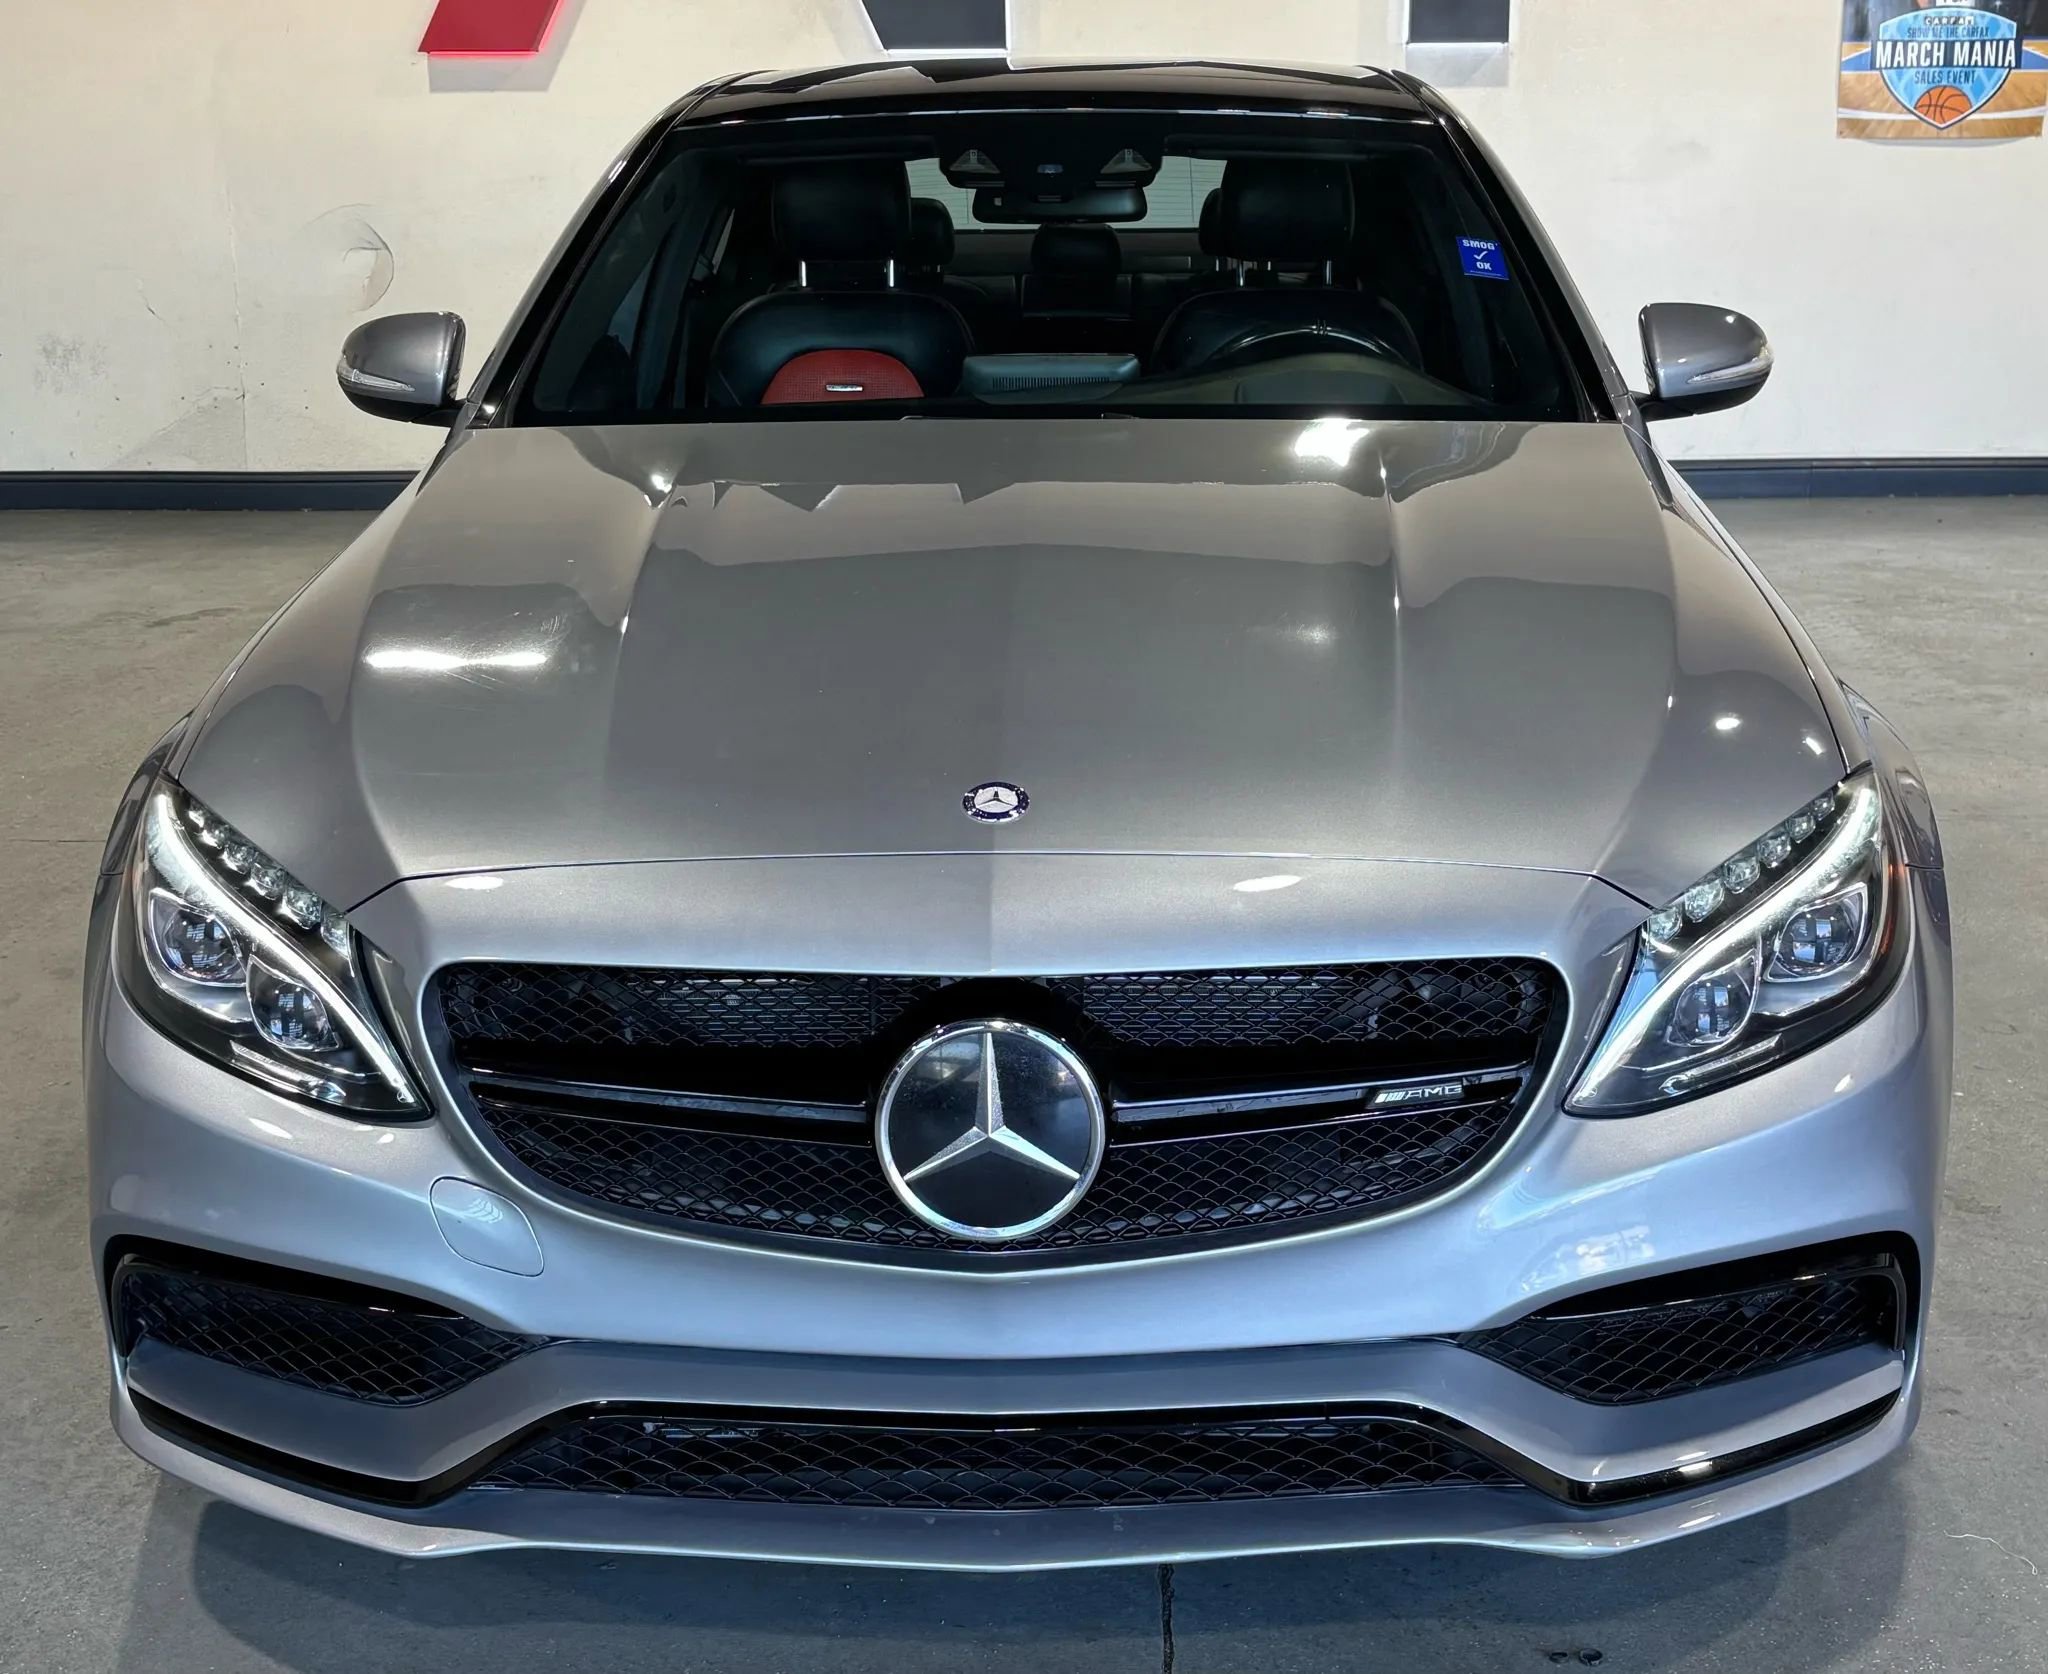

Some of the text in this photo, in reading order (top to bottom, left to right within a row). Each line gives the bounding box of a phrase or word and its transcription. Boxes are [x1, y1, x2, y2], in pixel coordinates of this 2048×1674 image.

[1908, 26, 1989, 38] SHOW ME THE CARFAX
[1876, 40, 2016, 68] MARCH MANIA
[1914, 70, 1976, 84] SALES EVENT
[1462, 239, 1495, 250] SMOG
[1476, 261, 1492, 271] OK
[1404, 1084, 1463, 1101] AMG
